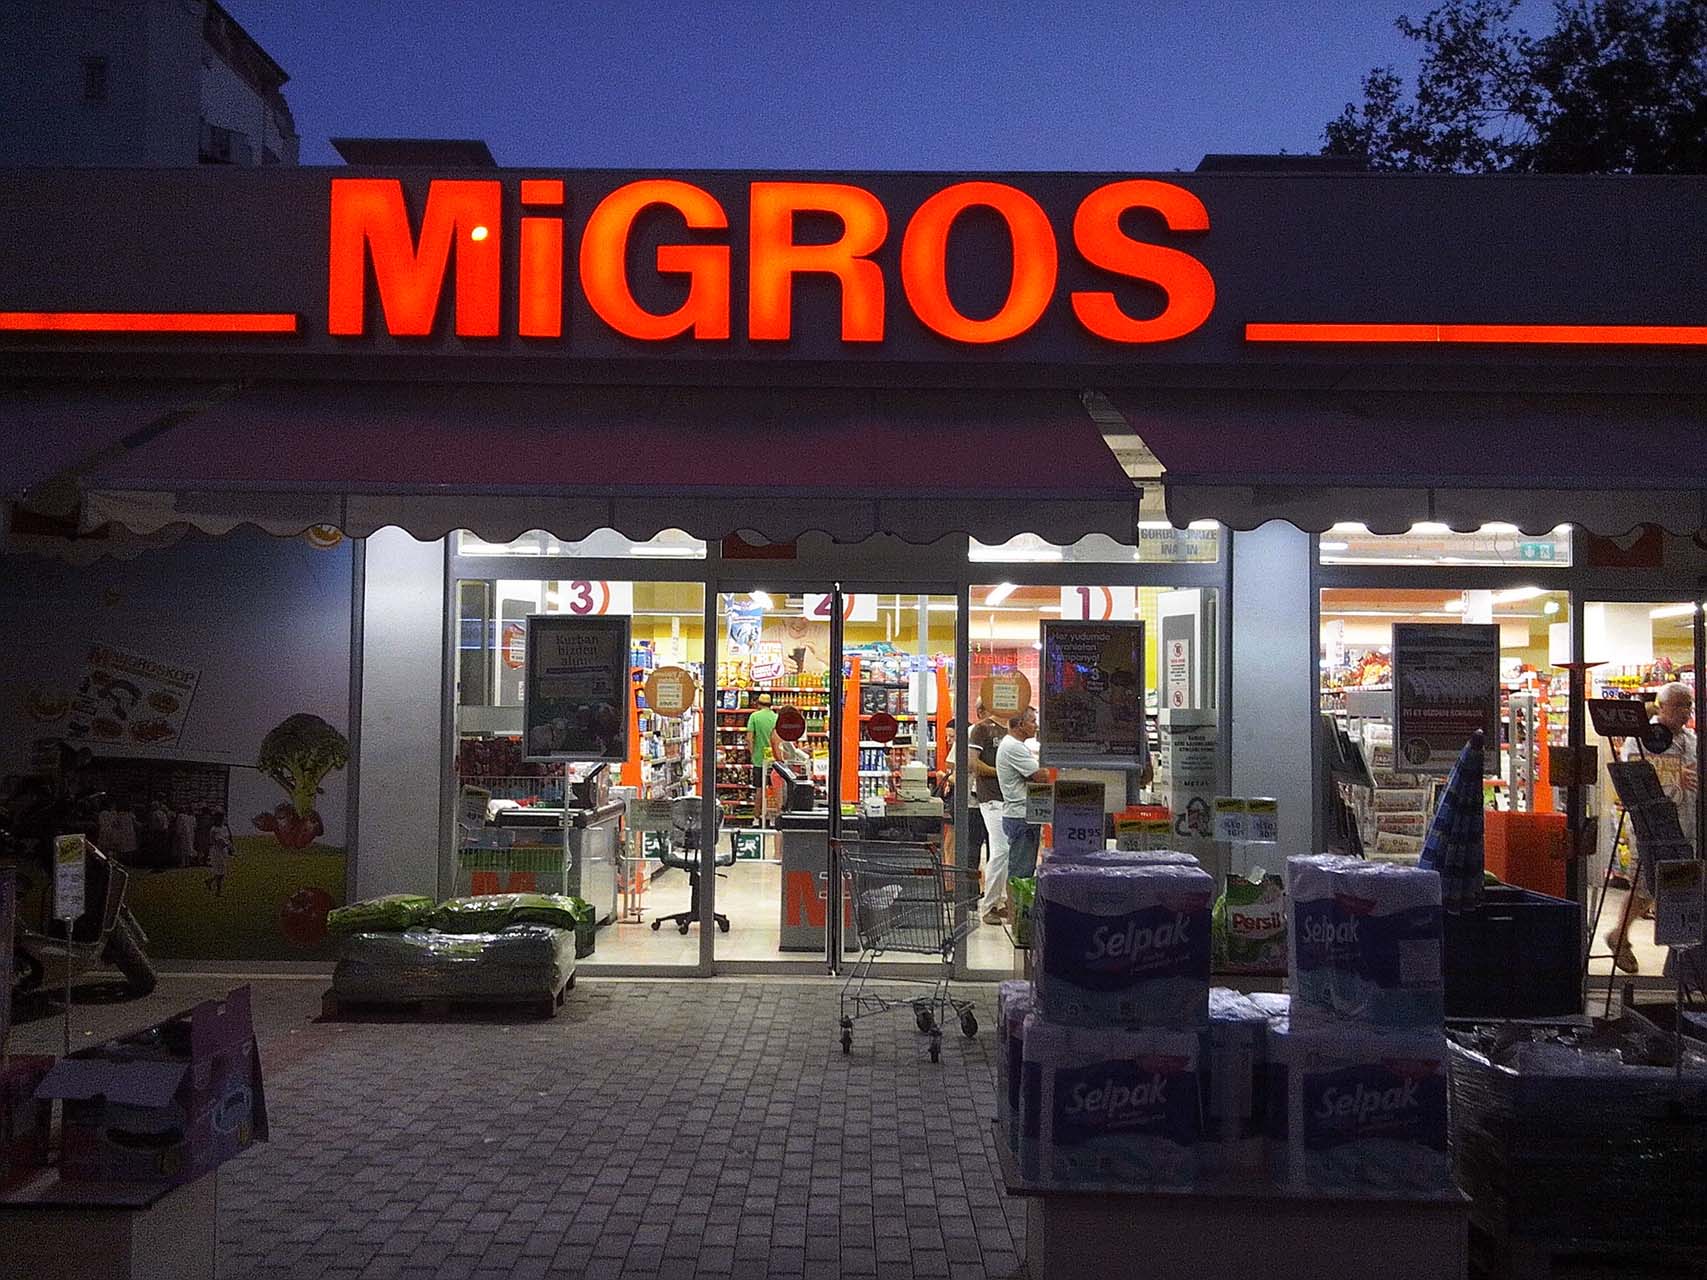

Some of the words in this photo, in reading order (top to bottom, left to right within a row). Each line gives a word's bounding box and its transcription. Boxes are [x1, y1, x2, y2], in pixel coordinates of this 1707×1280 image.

[328, 178, 1216, 343] MiGROS
[570, 580, 594, 615] 3
[1076, 587, 1090, 621] 1
[1084, 912, 1191, 961] Selpak
[1232, 912, 1281, 930] Persil
[1302, 913, 1361, 949] Selpak
[1063, 1069, 1169, 1121] Selpak
[1313, 1077, 1419, 1125] Selpak
